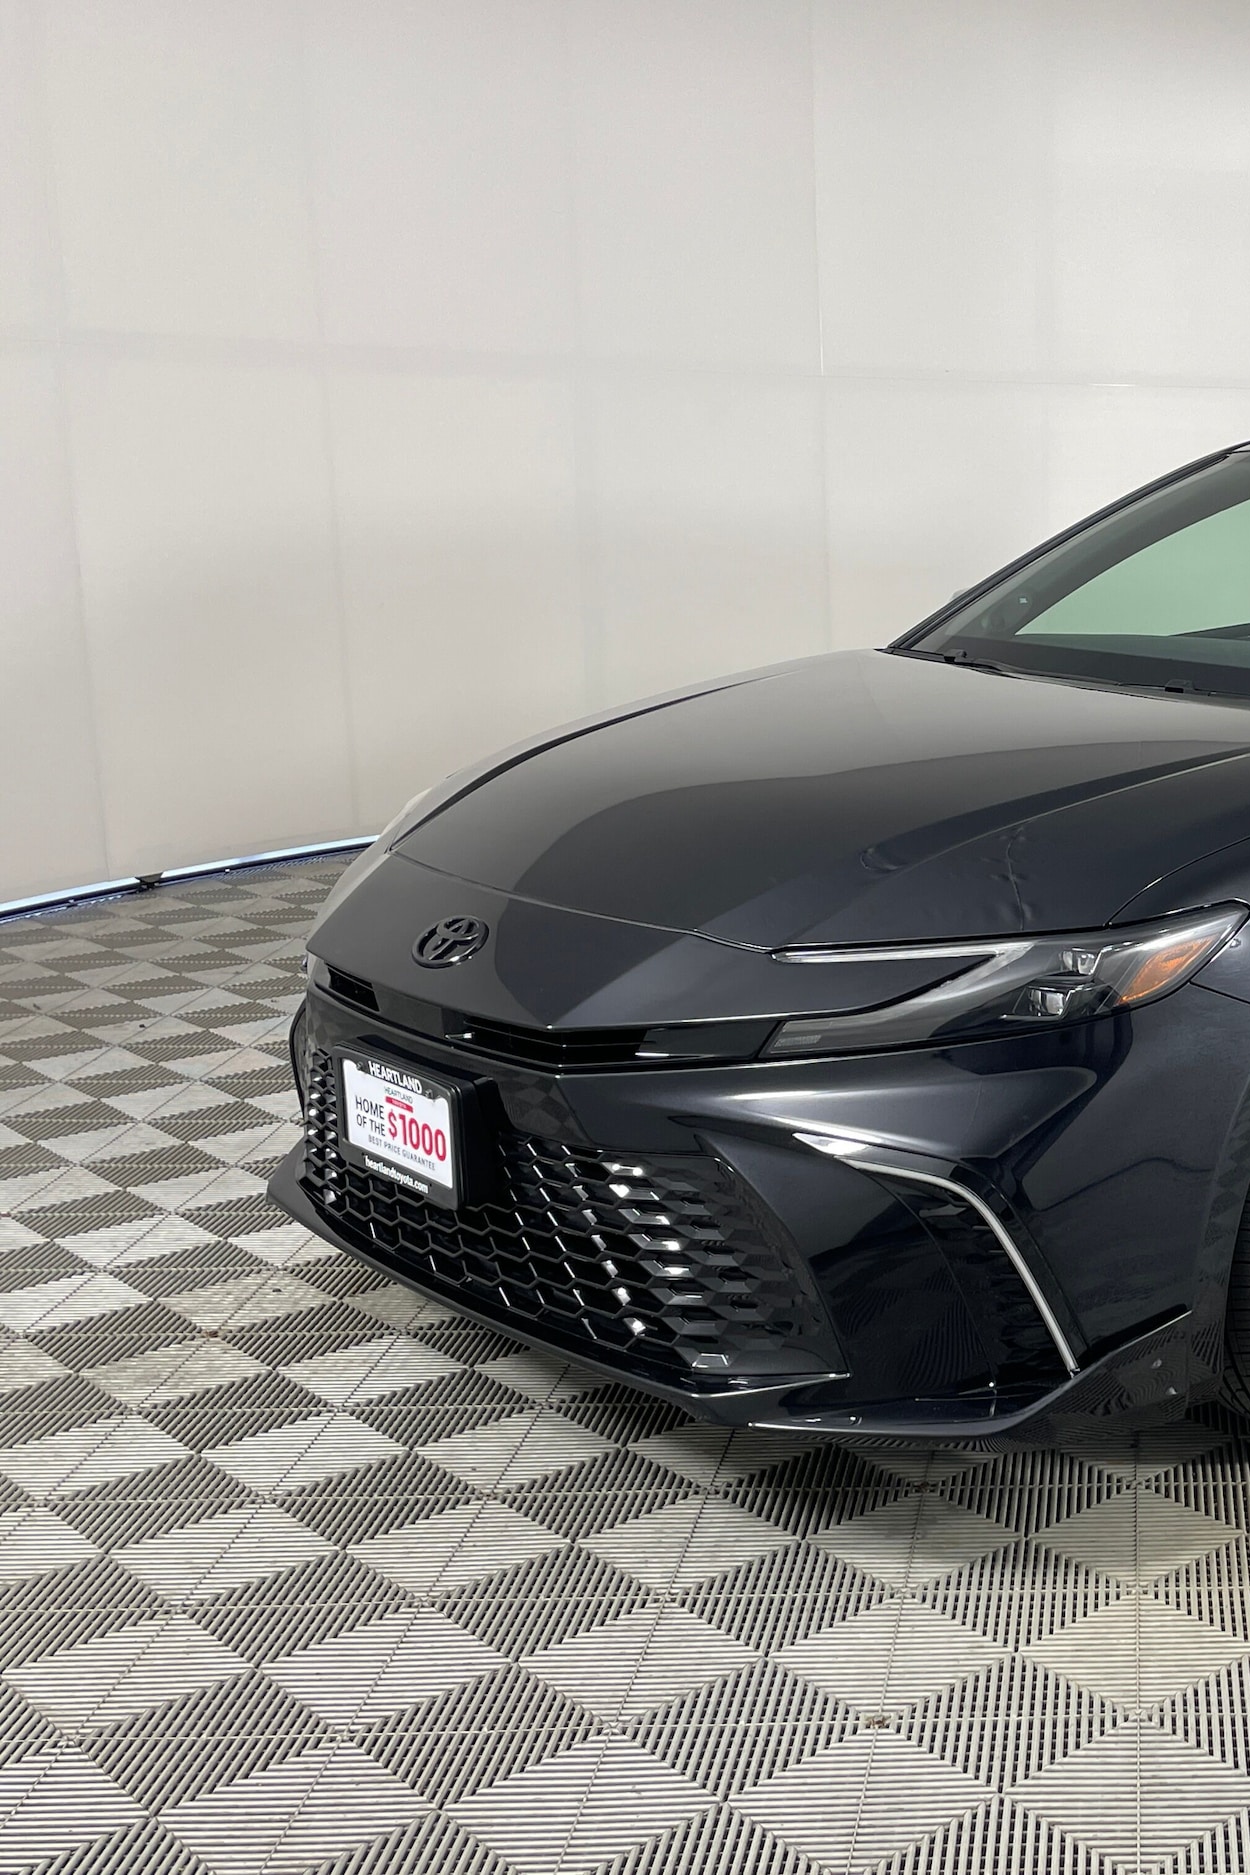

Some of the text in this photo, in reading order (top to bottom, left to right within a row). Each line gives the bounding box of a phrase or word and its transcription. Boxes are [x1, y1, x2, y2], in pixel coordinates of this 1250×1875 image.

[368, 1061, 422, 1094] HEARTLAND
[355, 1096, 385, 1120] HOME
[384, 1086, 413, 1104] HEARTLAND
[356, 1113, 386, 1137] OF THE
[388, 1109, 447, 1162] $1000
[368, 1134, 435, 1171] BEST PRICE GUARANTEE
[365, 1156, 429, 1194] heartlandtoyota.com
